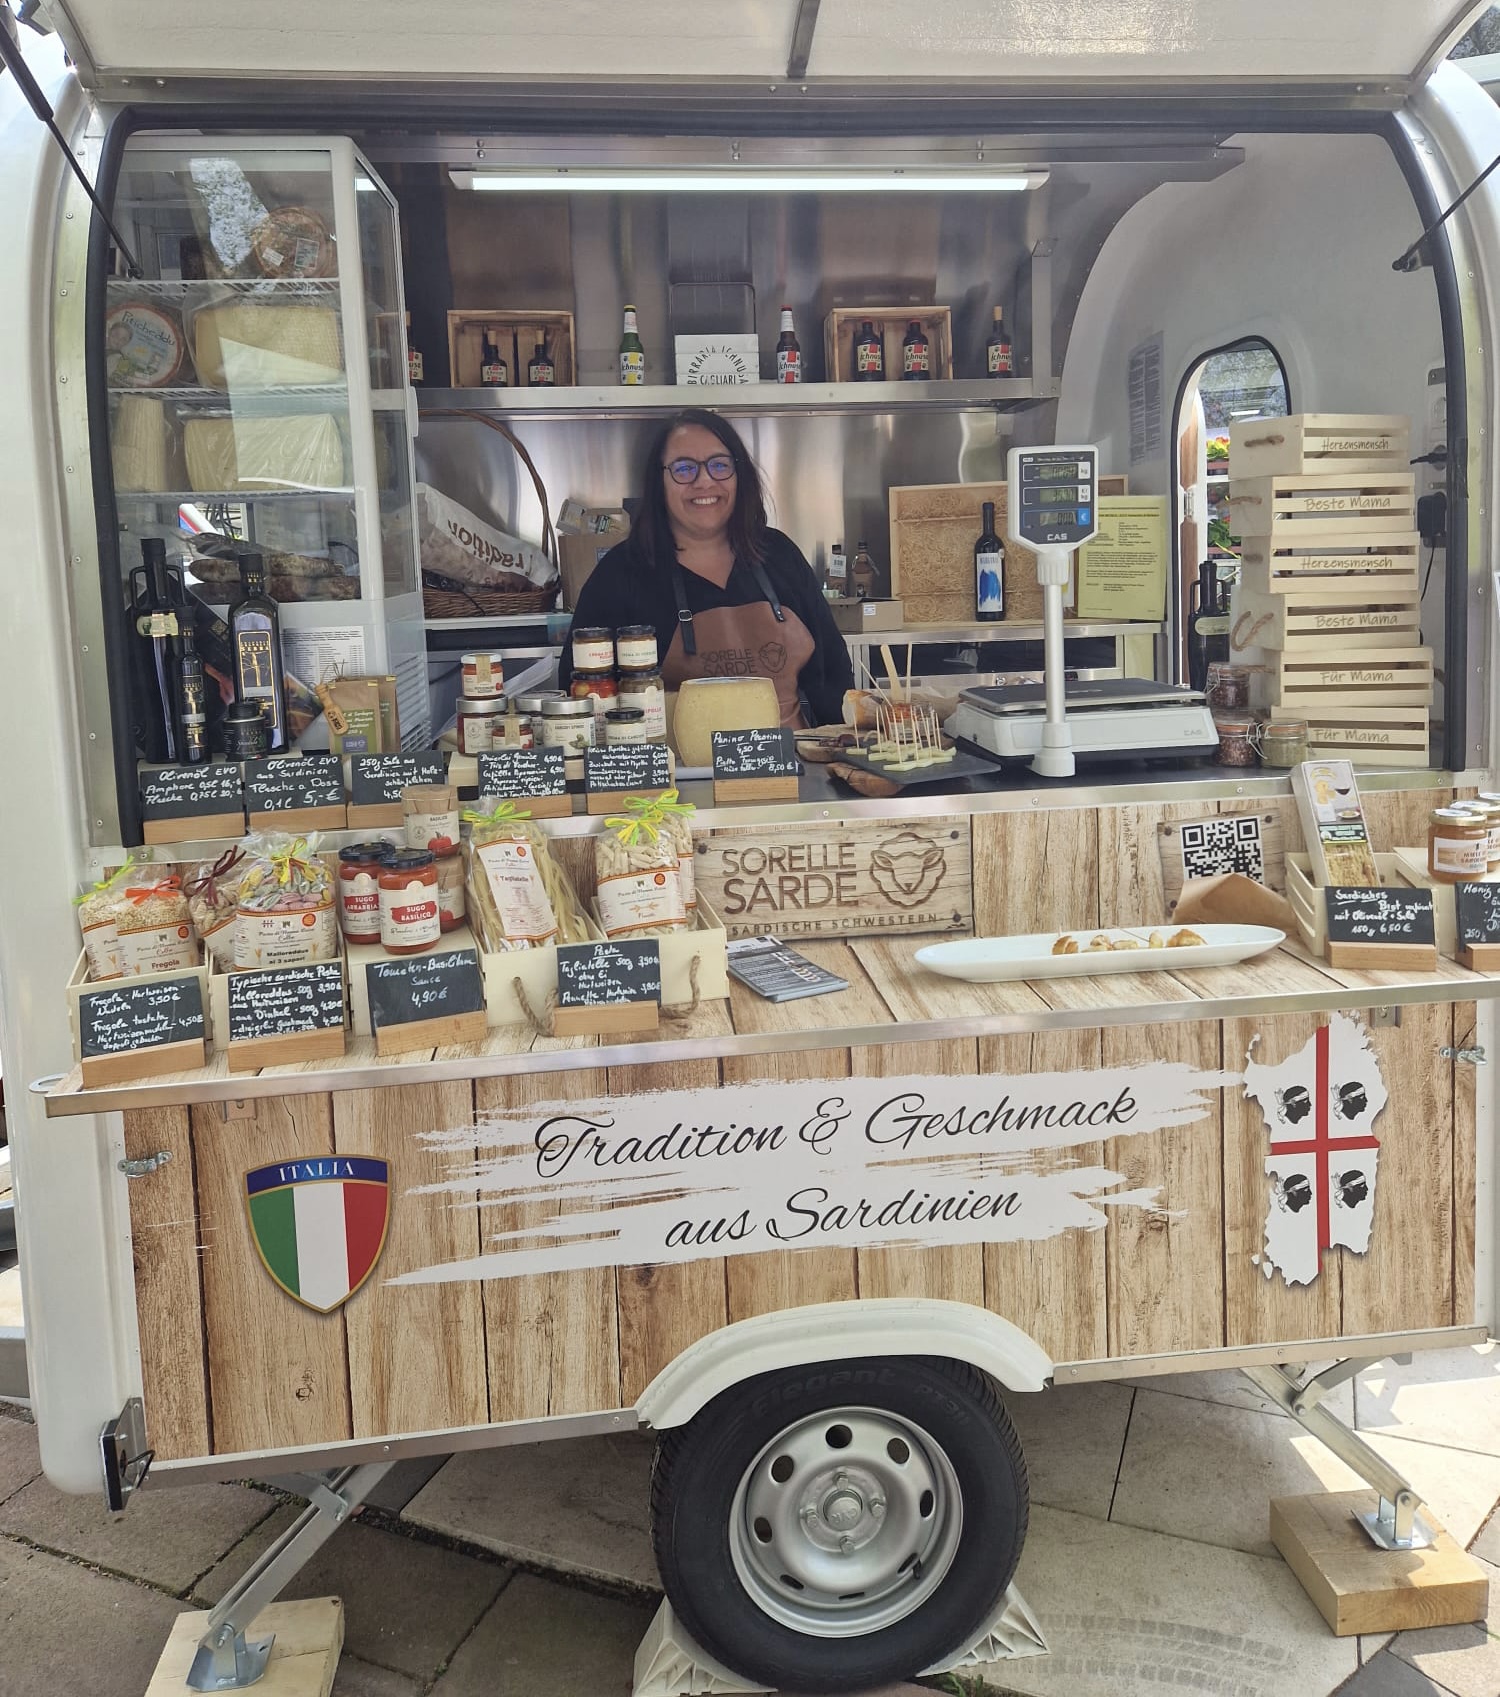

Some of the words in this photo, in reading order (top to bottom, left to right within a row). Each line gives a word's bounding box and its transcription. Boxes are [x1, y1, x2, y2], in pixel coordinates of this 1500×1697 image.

[1322, 437, 1389, 451] Herzensmensch
[1304, 497, 1345, 510] Beste
[1350, 496, 1391, 508] Mama
[1047, 532, 1068, 541] CAS
[1301, 556, 1393, 570] Herzensmensch
[1315, 615, 1355, 627] Beste
[1359, 613, 1398, 625] Mama
[701, 648, 753, 663] SORELLE
[703, 660, 758, 678] SARDE
[1320, 671, 1344, 685] Für
[1351, 670, 1393, 682] Mama
[713, 731, 745, 744] Panino
[1313, 728, 1341, 741] Für
[1345, 730, 1390, 743] Mama
[736, 745, 753, 756] 4,50
[267, 757, 314, 770] Olivenöl
[319, 756, 338, 765] EVO
[159, 766, 209, 781] Olivenöl
[215, 766, 237, 776] EVO
[279, 768, 328, 778] Sardinien
[248, 780, 295, 793] Flasche
[310, 777, 340, 787] Dose
[721, 842, 857, 877] SORELLE
[723, 870, 859, 915] SARDE
[1335, 889, 1388, 900] Sardisches
[1463, 884, 1492, 899] Honig
[406, 904, 426, 913] SUGO
[1379, 900, 1401, 911] Brot
[401, 911, 432, 921] BASILICO
[1334, 910, 1350, 920] mit
[732, 921, 822, 936] SARDISCHE
[832, 913, 937, 929] SCHWESTERN
[1379, 922, 1401, 936] 6,50
[594, 944, 620, 957] Pasta
[151, 959, 180, 968] Fregola
[560, 959, 610, 978] Tagliatelle
[231, 973, 272, 993] Typische
[274, 969, 314, 981] sardische
[316, 965, 341, 977] Pasta
[598, 970, 607, 979] Ei
[90, 994, 123, 1008] Fregola
[232, 987, 293, 1003] Malloreddus
[254, 1006, 291, 1020] Dinkel
[91, 1017, 129, 1034] Fregola
[535, 1116, 788, 1177] Tradition
[798, 1097, 852, 1155] &
[865, 1086, 1139, 1150] Geschmack
[279, 1161, 355, 1182] ITALIA
[665, 1209, 757, 1248] aus
[765, 1187, 1023, 1242] Sardinien
